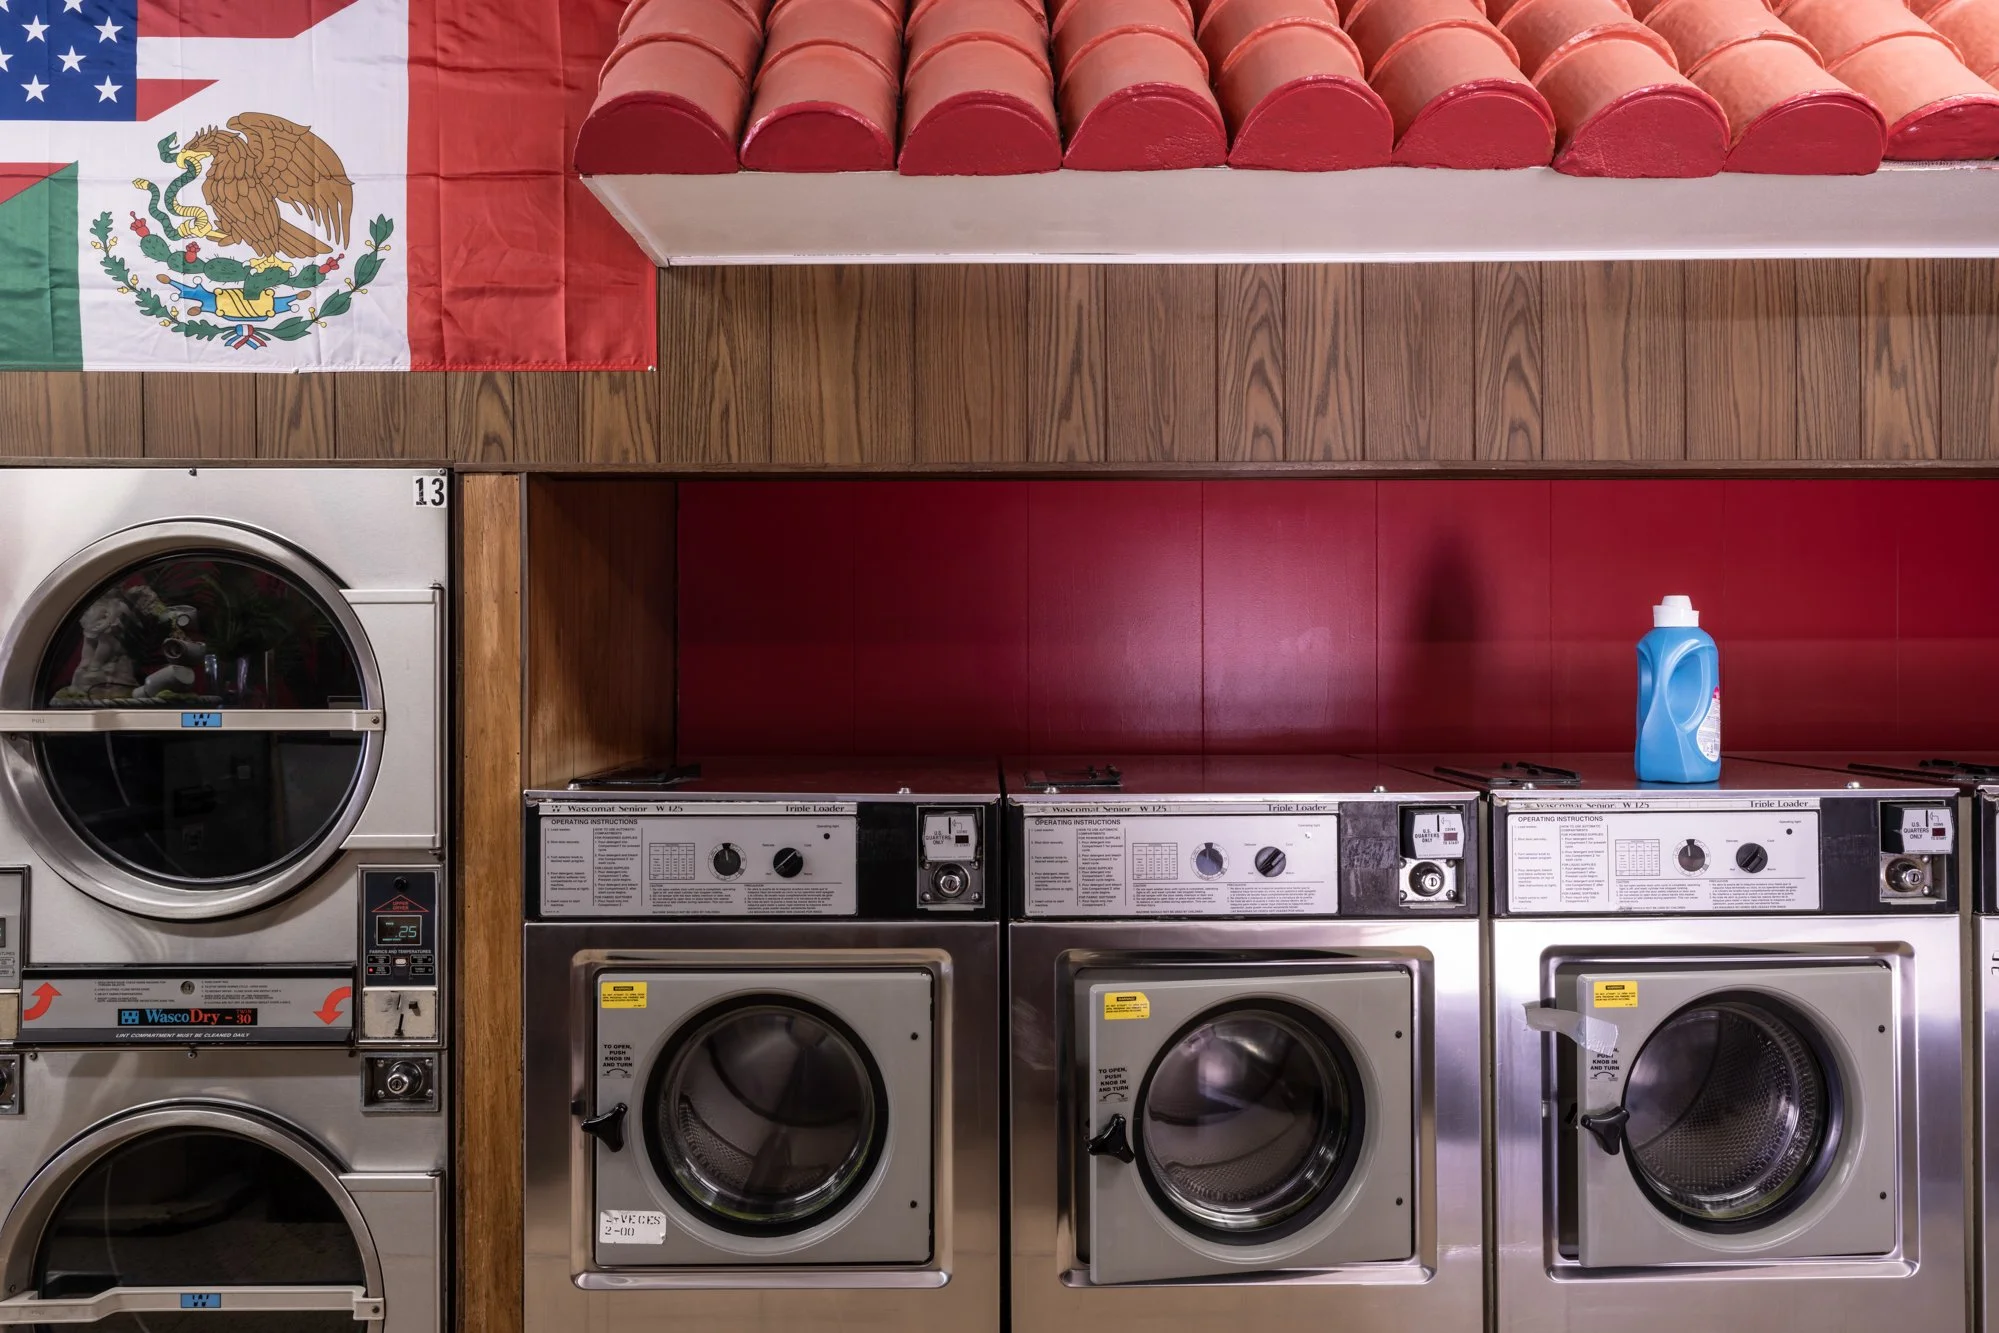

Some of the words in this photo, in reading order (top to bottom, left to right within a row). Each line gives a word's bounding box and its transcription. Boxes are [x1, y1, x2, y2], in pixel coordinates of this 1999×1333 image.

[416, 477, 444, 506] 13
[1268, 804, 1293, 812] Triple
[1296, 804, 1327, 812] Loader
[1750, 800, 1775, 808] Triple
[1778, 800, 1808, 808] Loader
[395, 926, 416, 937] .25
[146, 1009, 220, 1024] WascoDry
[237, 1014, 251, 1024] 30
